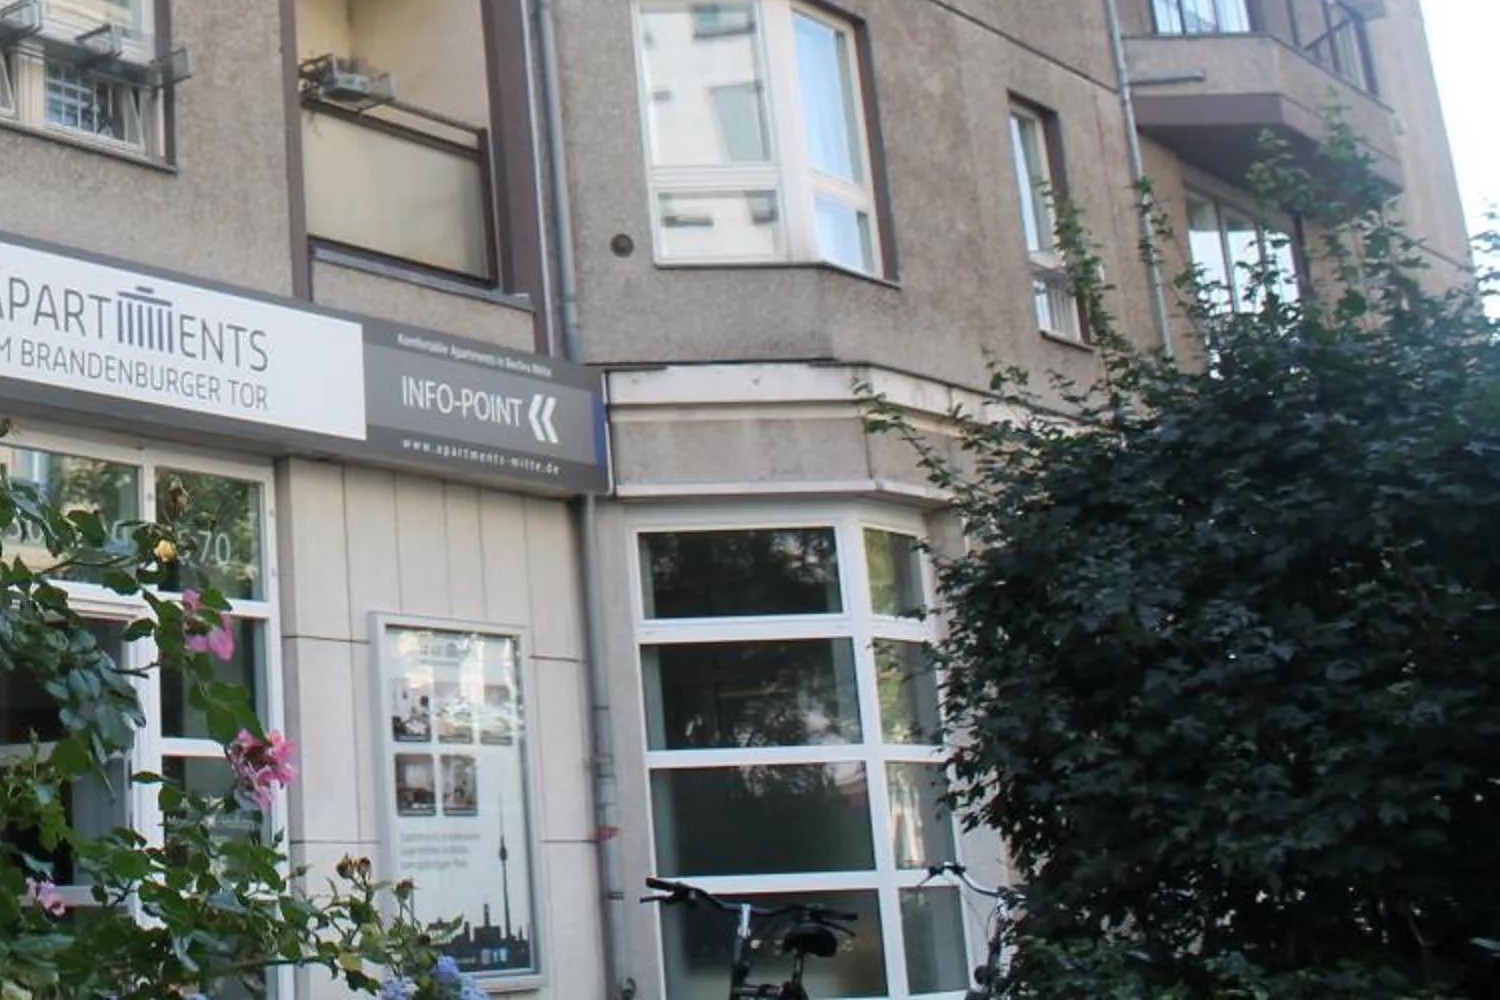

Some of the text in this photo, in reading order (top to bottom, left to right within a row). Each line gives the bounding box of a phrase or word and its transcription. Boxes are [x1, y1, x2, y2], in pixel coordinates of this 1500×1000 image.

[20, 335, 221, 403] BRANDENBURGER
[228, 379, 269, 411] TOR
[401, 375, 523, 428] INFO-POINT
